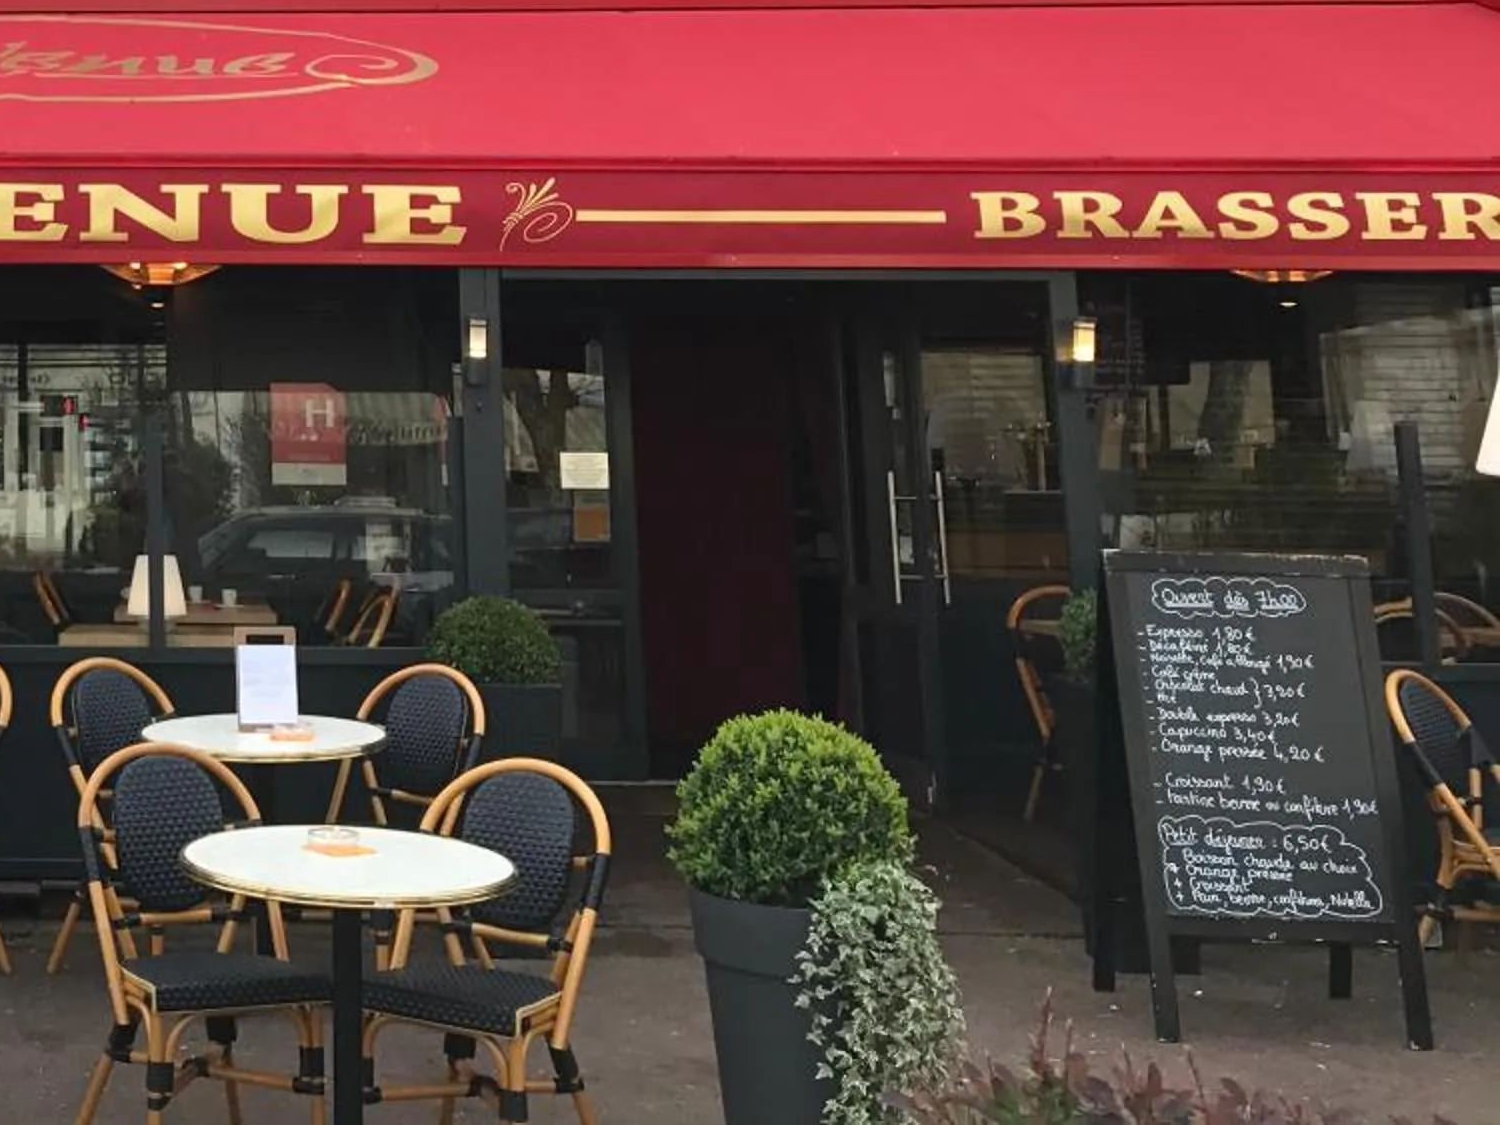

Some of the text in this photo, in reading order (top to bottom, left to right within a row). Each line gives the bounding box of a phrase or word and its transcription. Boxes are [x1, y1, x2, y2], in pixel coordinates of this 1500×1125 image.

[971, 191, 1500, 239] BRASSER
[305, 398, 334, 428] H
[1161, 588, 1213, 607] Ouvert
[1165, 773, 1234, 789] Croissant
